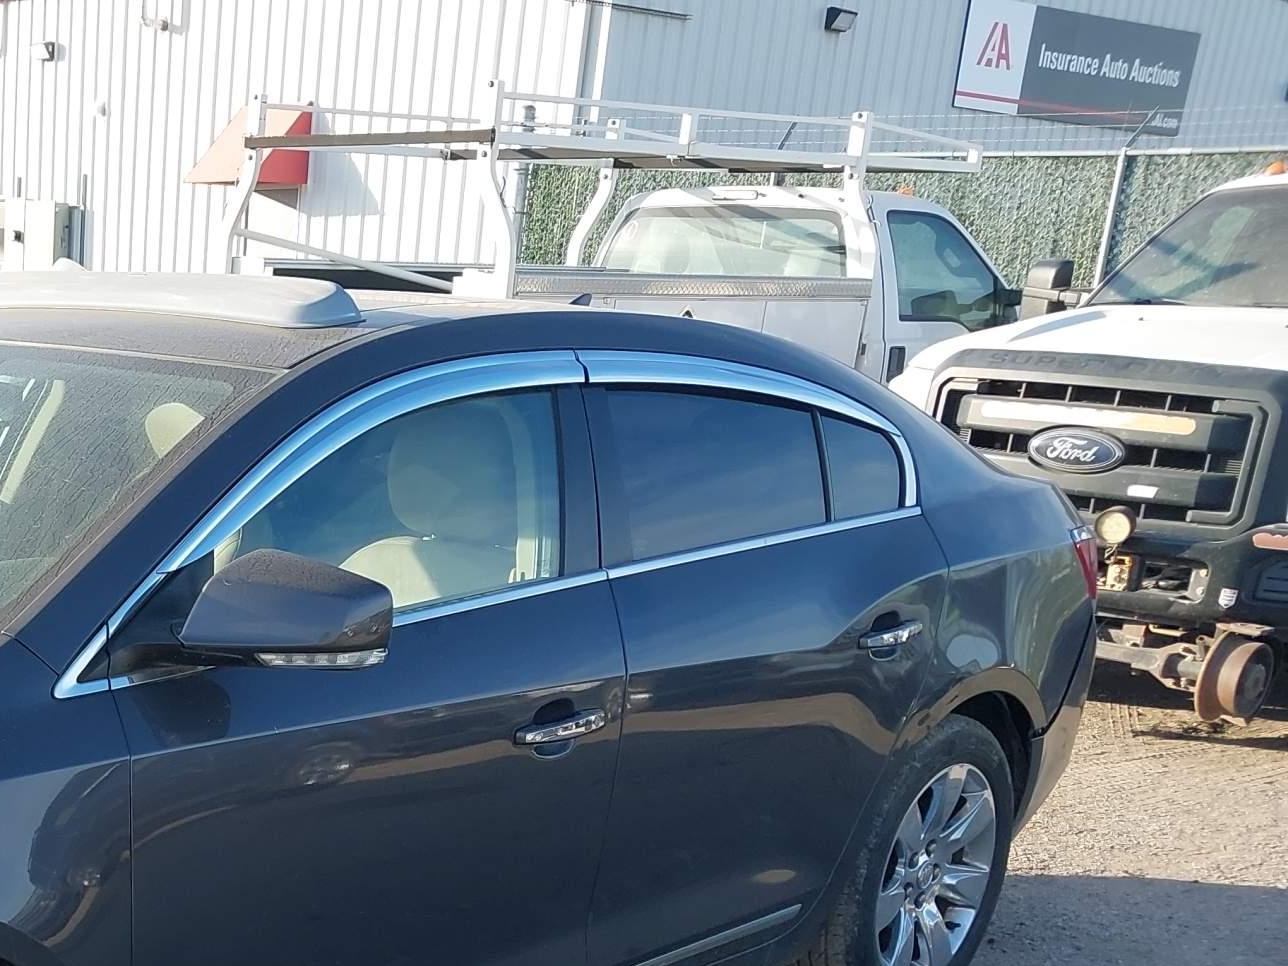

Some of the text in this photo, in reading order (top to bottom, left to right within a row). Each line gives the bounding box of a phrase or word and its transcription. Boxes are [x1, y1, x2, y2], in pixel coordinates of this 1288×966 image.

[1038, 43, 1181, 88] Insurance Auto Auctions
[1046, 437, 1100, 462] Ford
